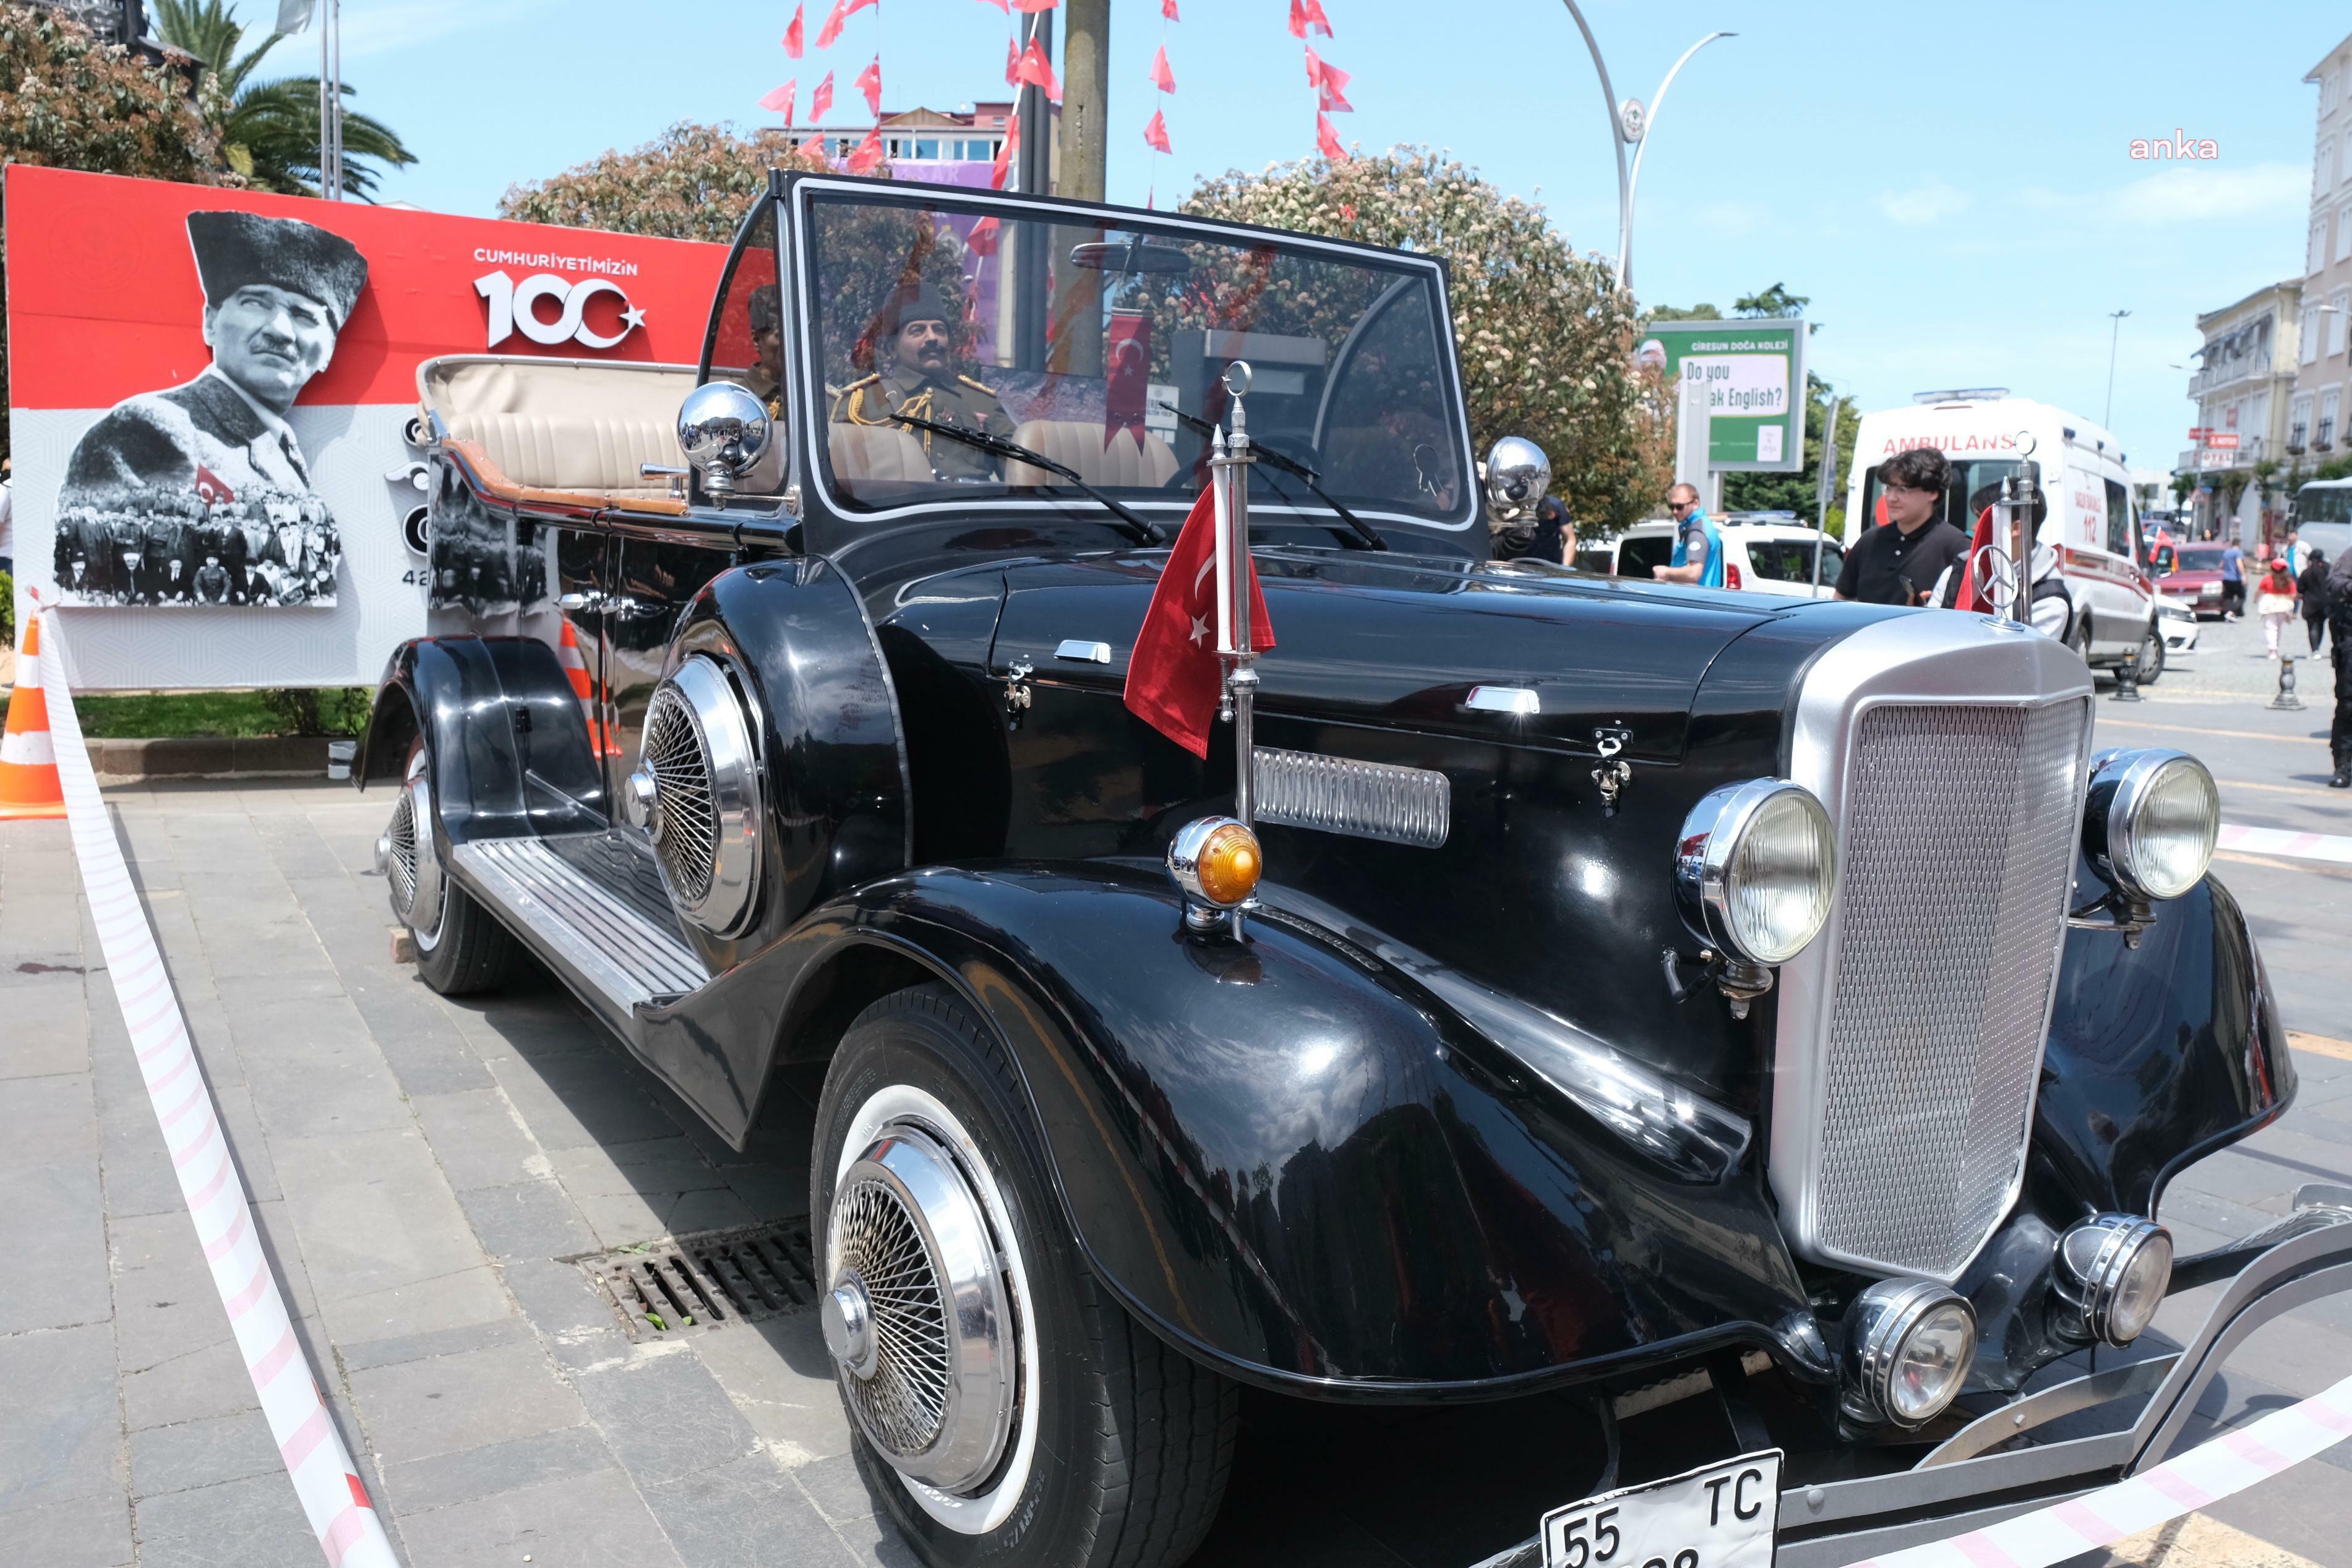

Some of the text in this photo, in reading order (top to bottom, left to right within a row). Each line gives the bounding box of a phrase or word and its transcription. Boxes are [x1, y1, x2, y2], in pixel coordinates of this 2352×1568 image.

[473, 247, 638, 276] CUMHURİYETİMİZİN
[473, 270, 632, 348] 100
[1730, 340, 1756, 351] DOĞA
[1758, 339, 1788, 351] KOLEJİ
[1687, 361, 1730, 382] Do you
[1728, 387, 1782, 409] English?
[1883, 434, 2015, 454] AMBULANS
[2084, 514, 2097, 542] 112
[1563, 1468, 1762, 1568] 55 TC
